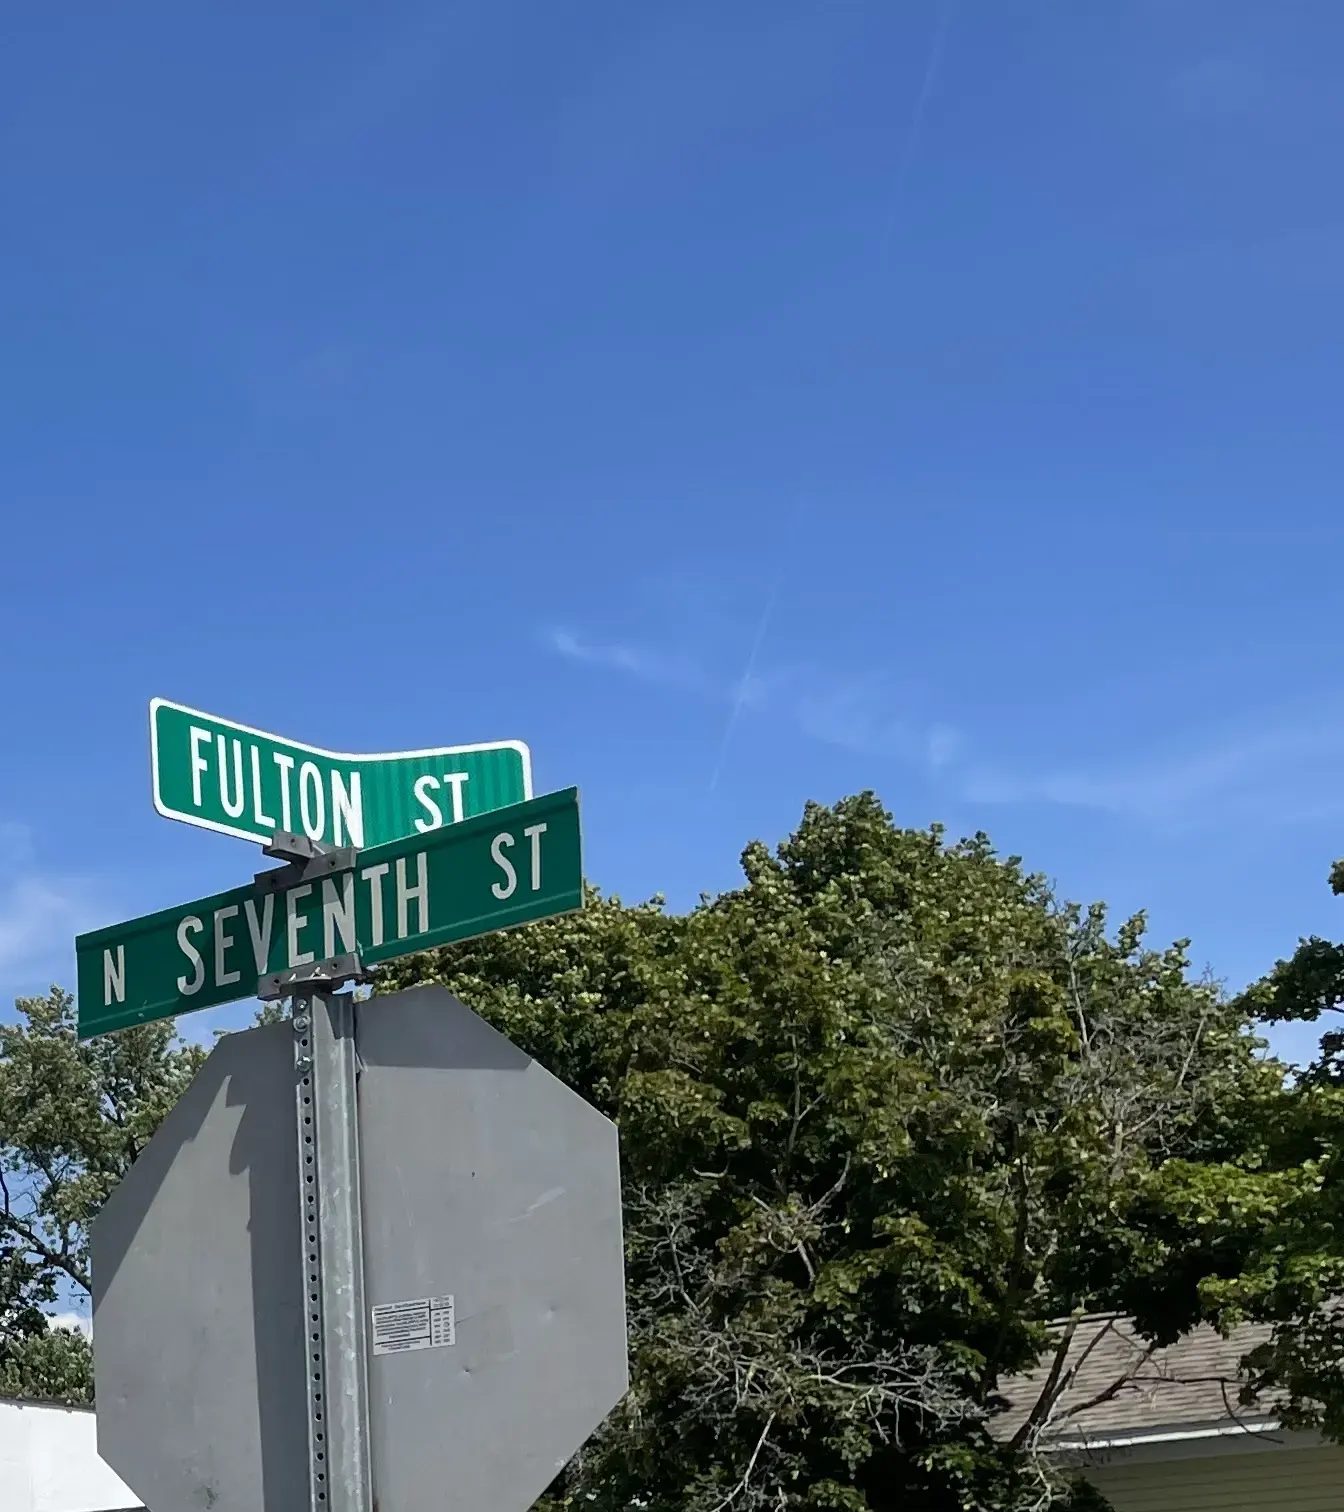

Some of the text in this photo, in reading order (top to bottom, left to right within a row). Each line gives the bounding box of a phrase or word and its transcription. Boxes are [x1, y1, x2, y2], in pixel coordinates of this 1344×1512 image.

[189, 725, 469, 848] FULTON ST
[103, 823, 548, 1006] N SEVENTH ST
